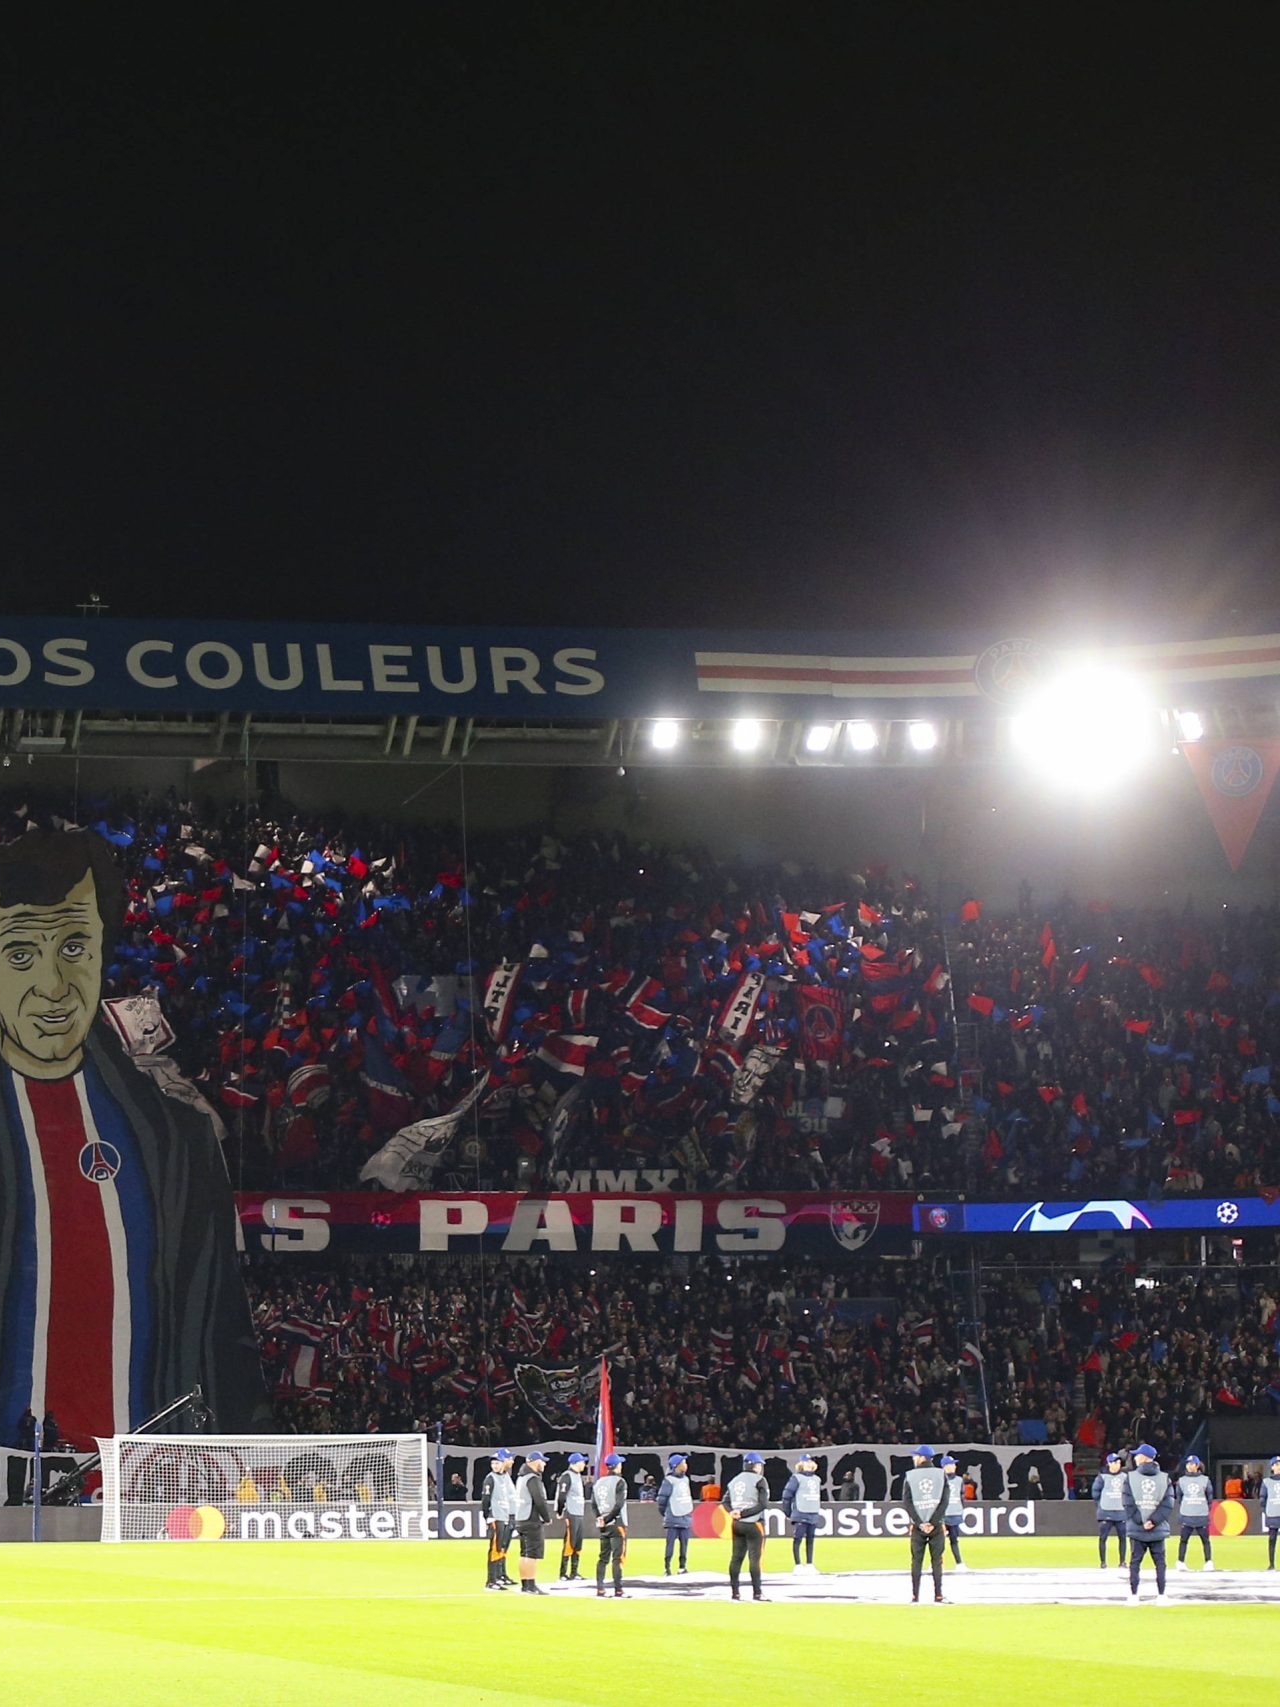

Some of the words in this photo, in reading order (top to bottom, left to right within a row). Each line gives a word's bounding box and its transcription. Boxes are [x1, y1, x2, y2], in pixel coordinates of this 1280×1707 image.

[125, 640, 606, 695] COULEURS
[419, 1198, 788, 1252] PARIS
[240, 1504, 519, 1540] masterca
